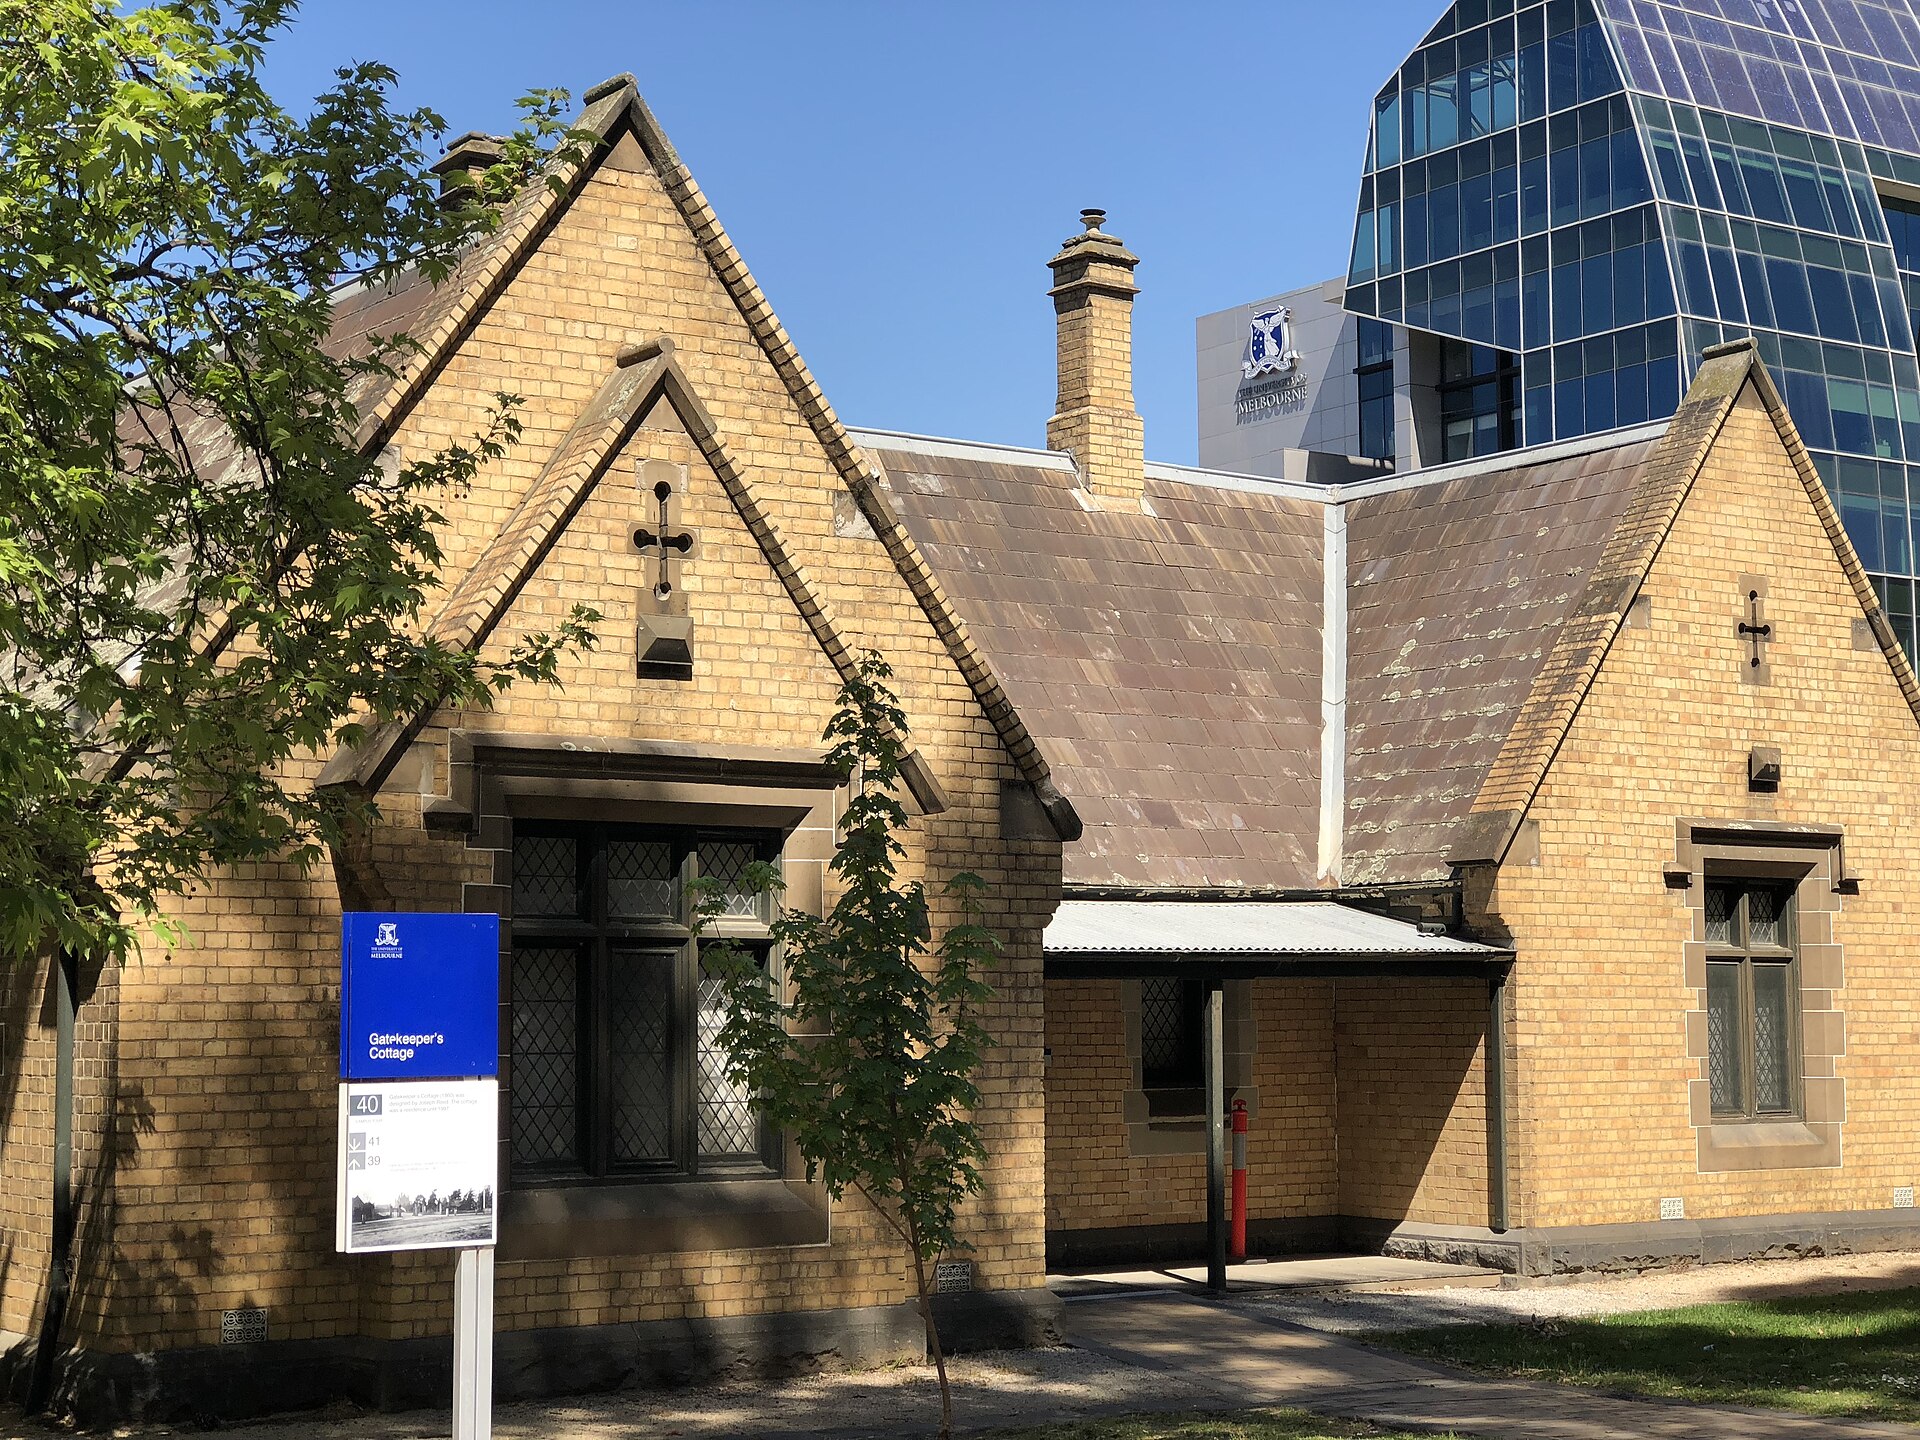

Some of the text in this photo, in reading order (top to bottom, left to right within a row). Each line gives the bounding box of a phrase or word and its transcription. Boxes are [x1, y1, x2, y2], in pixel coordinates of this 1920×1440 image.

[1238, 386, 1308, 415] MELBOURNE
[369, 1032, 444, 1047] Gatekeeper's
[369, 1047, 415, 1061] Cottage
[356, 1095, 379, 1113] 40
[368, 1136, 380, 1146] 41
[367, 1156, 381, 1166] 39
